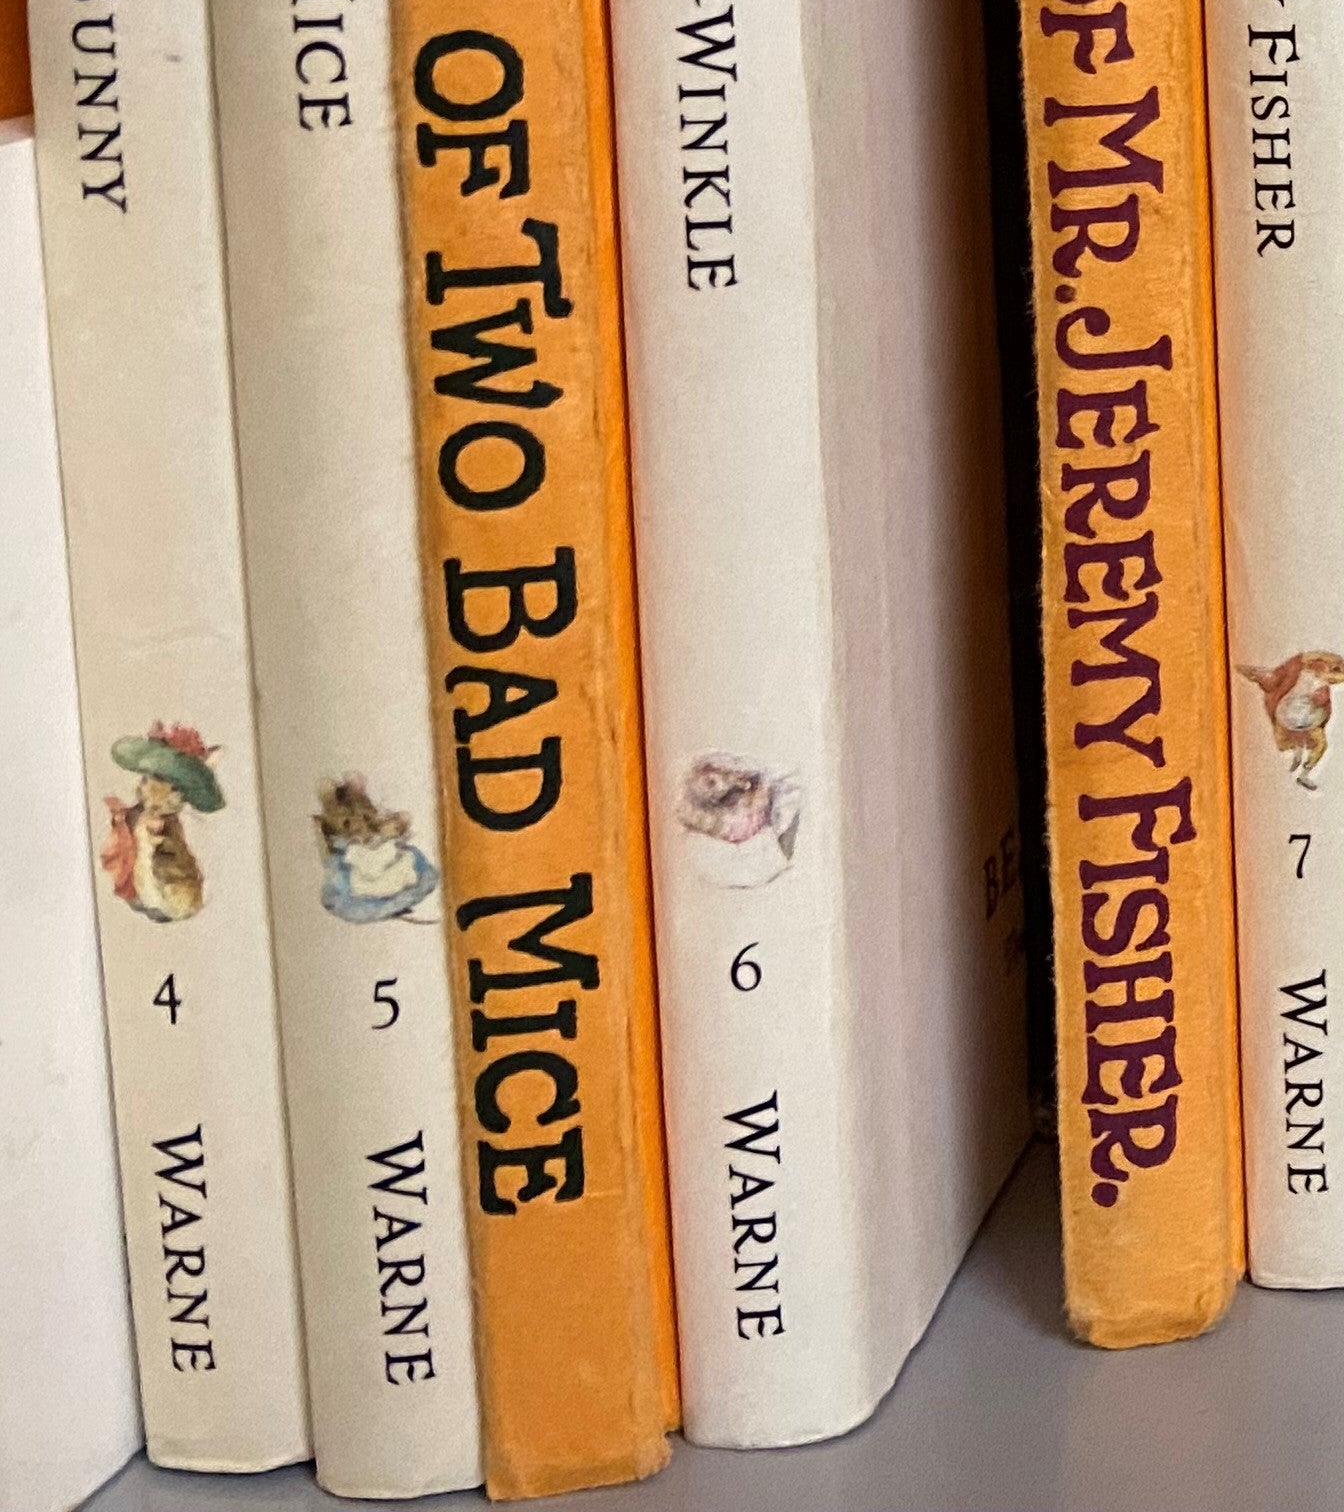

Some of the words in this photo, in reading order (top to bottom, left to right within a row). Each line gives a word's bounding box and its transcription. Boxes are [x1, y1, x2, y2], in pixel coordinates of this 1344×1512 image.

[412, 29, 531, 199] OF
[1247, 23, 1300, 258] FISHER
[424, 216, 573, 511] TWO
[442, 546, 576, 833] BAD
[729, 941, 762, 993] 6
[1287, 833, 1313, 880] 7
[153, 974, 182, 1026] 4
[371, 978, 400, 1029] 5
[456, 873, 600, 1215] MICE
[1075, 777, 1196, 1208] FISHER.
[1278, 969, 1329, 1196] WARNE
[150, 1123, 216, 1373] WARNE
[365, 1129, 435, 1386] WARNE
[722, 1091, 786, 1343] WARNE
